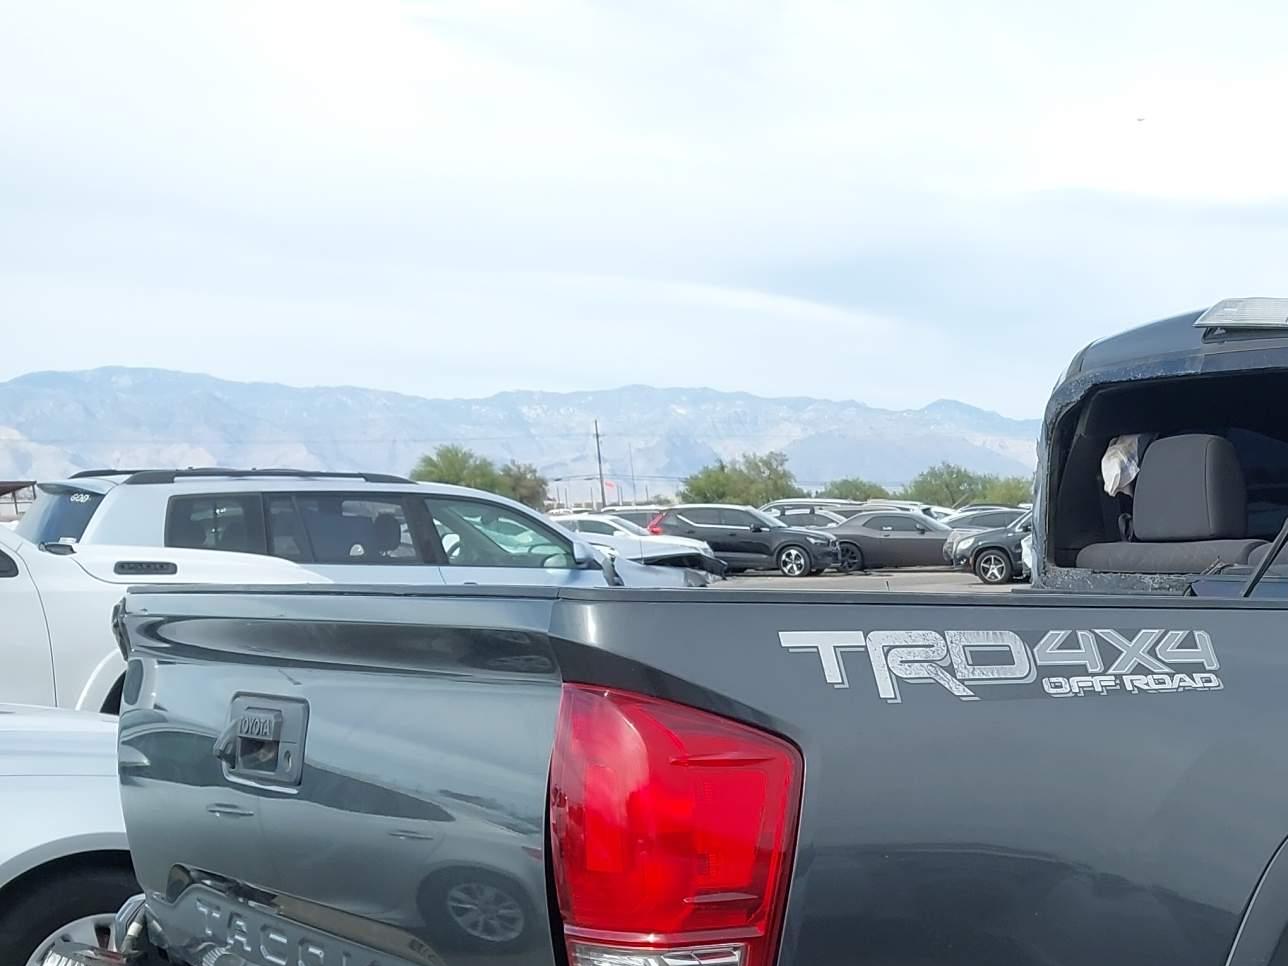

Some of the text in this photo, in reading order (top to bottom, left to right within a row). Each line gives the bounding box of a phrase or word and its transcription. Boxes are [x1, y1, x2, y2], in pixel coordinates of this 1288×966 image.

[778, 630, 1038, 704] TRD
[1042, 672, 1225, 698] OFF ROAD
